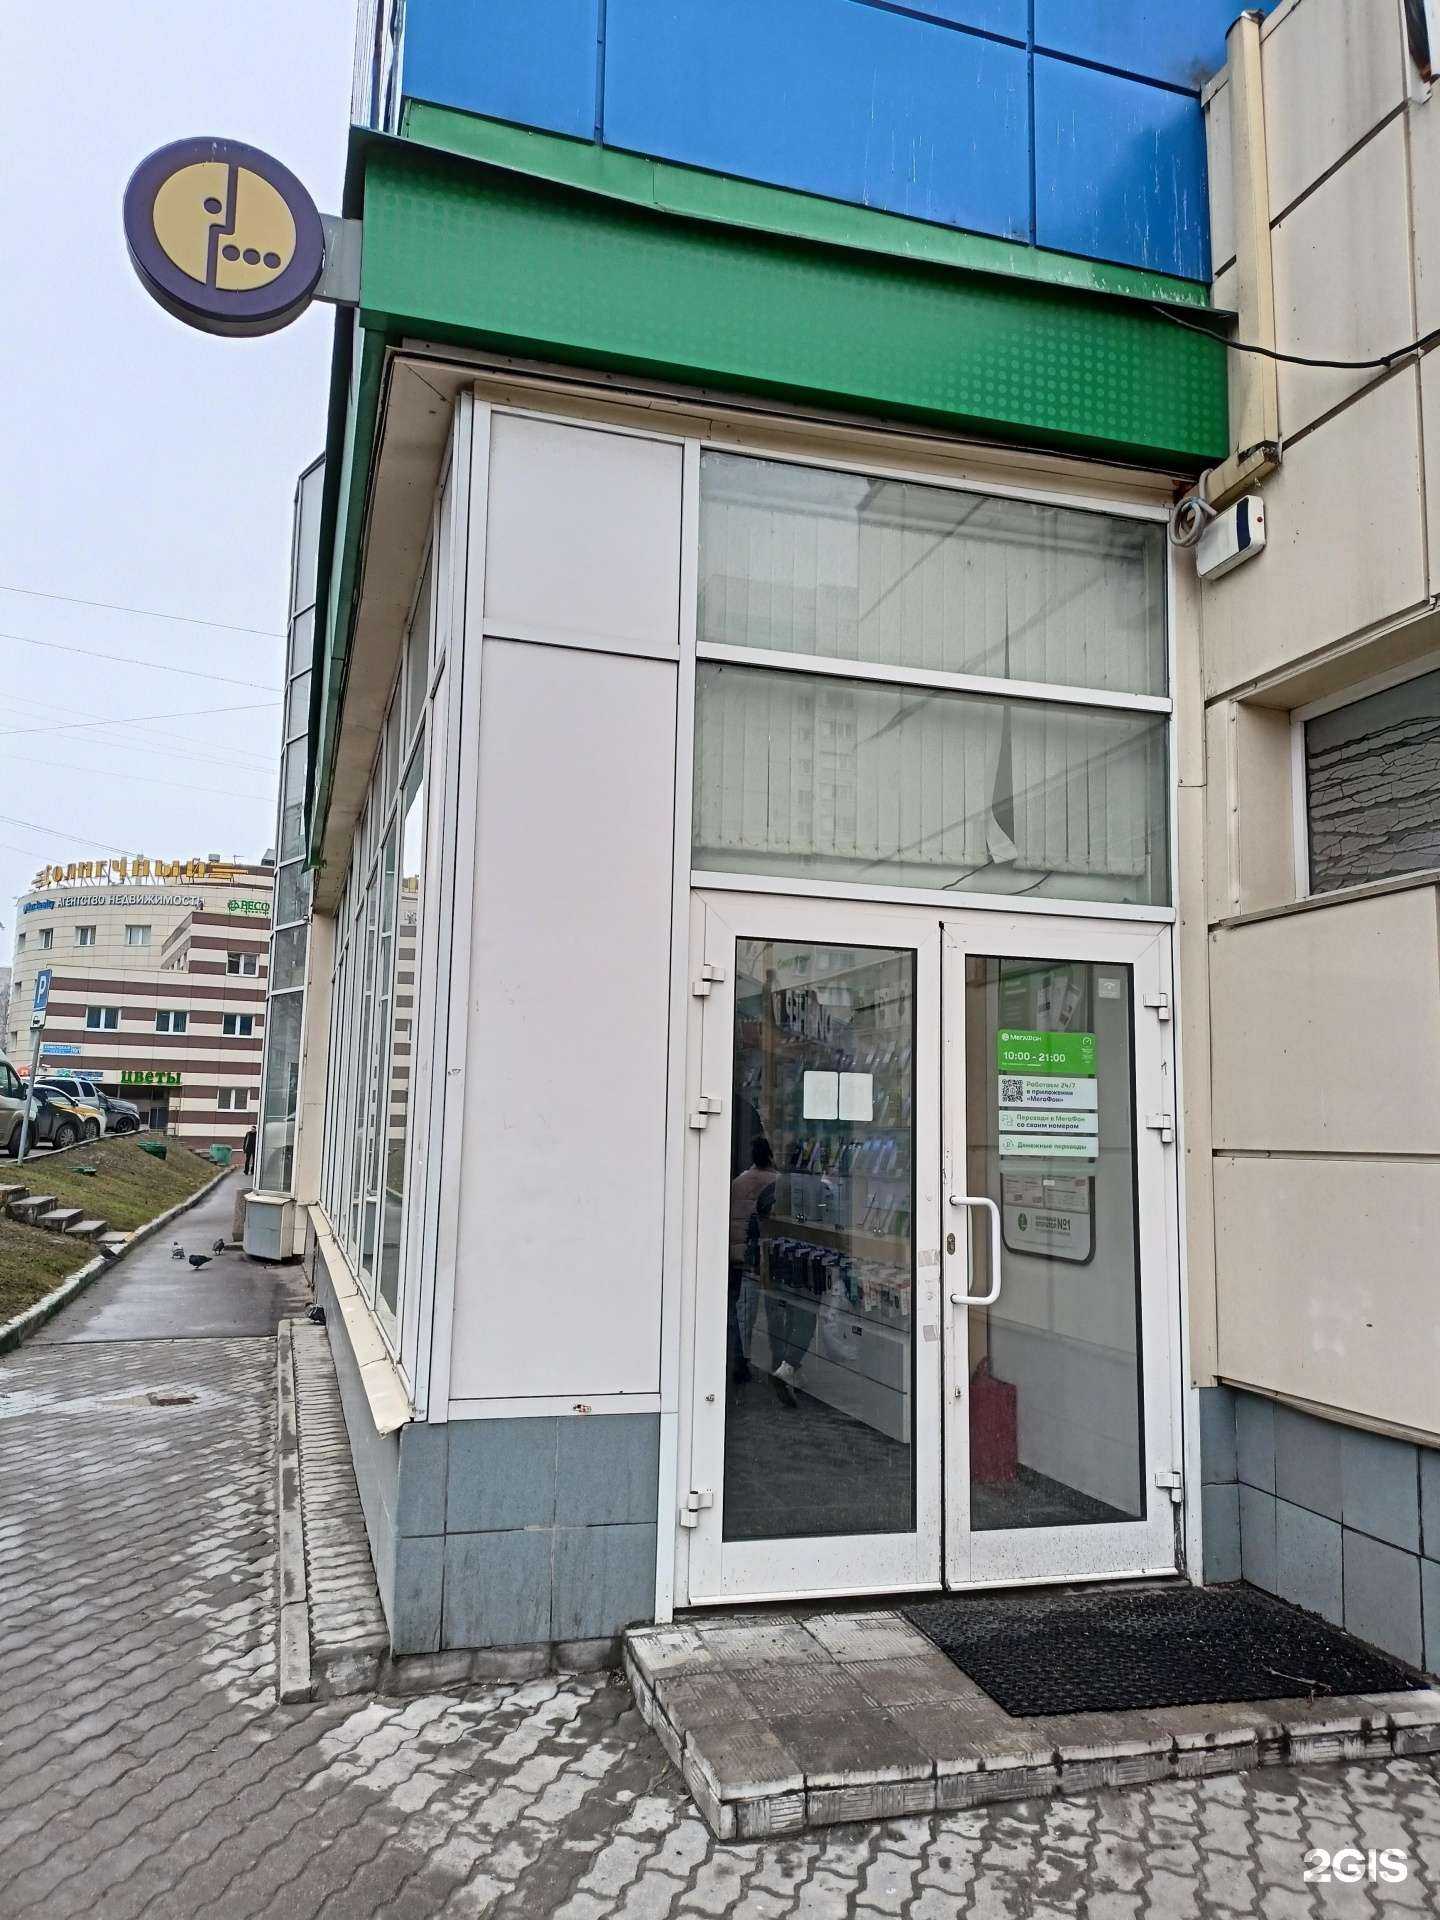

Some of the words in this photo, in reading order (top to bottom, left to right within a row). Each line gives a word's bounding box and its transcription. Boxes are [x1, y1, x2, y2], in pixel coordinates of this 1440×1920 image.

[58, 895, 105, 908] АГЕНТСТВО
[1003, 1051, 1030, 1060] 10:00
[1039, 1052, 1066, 1062] 21:00
